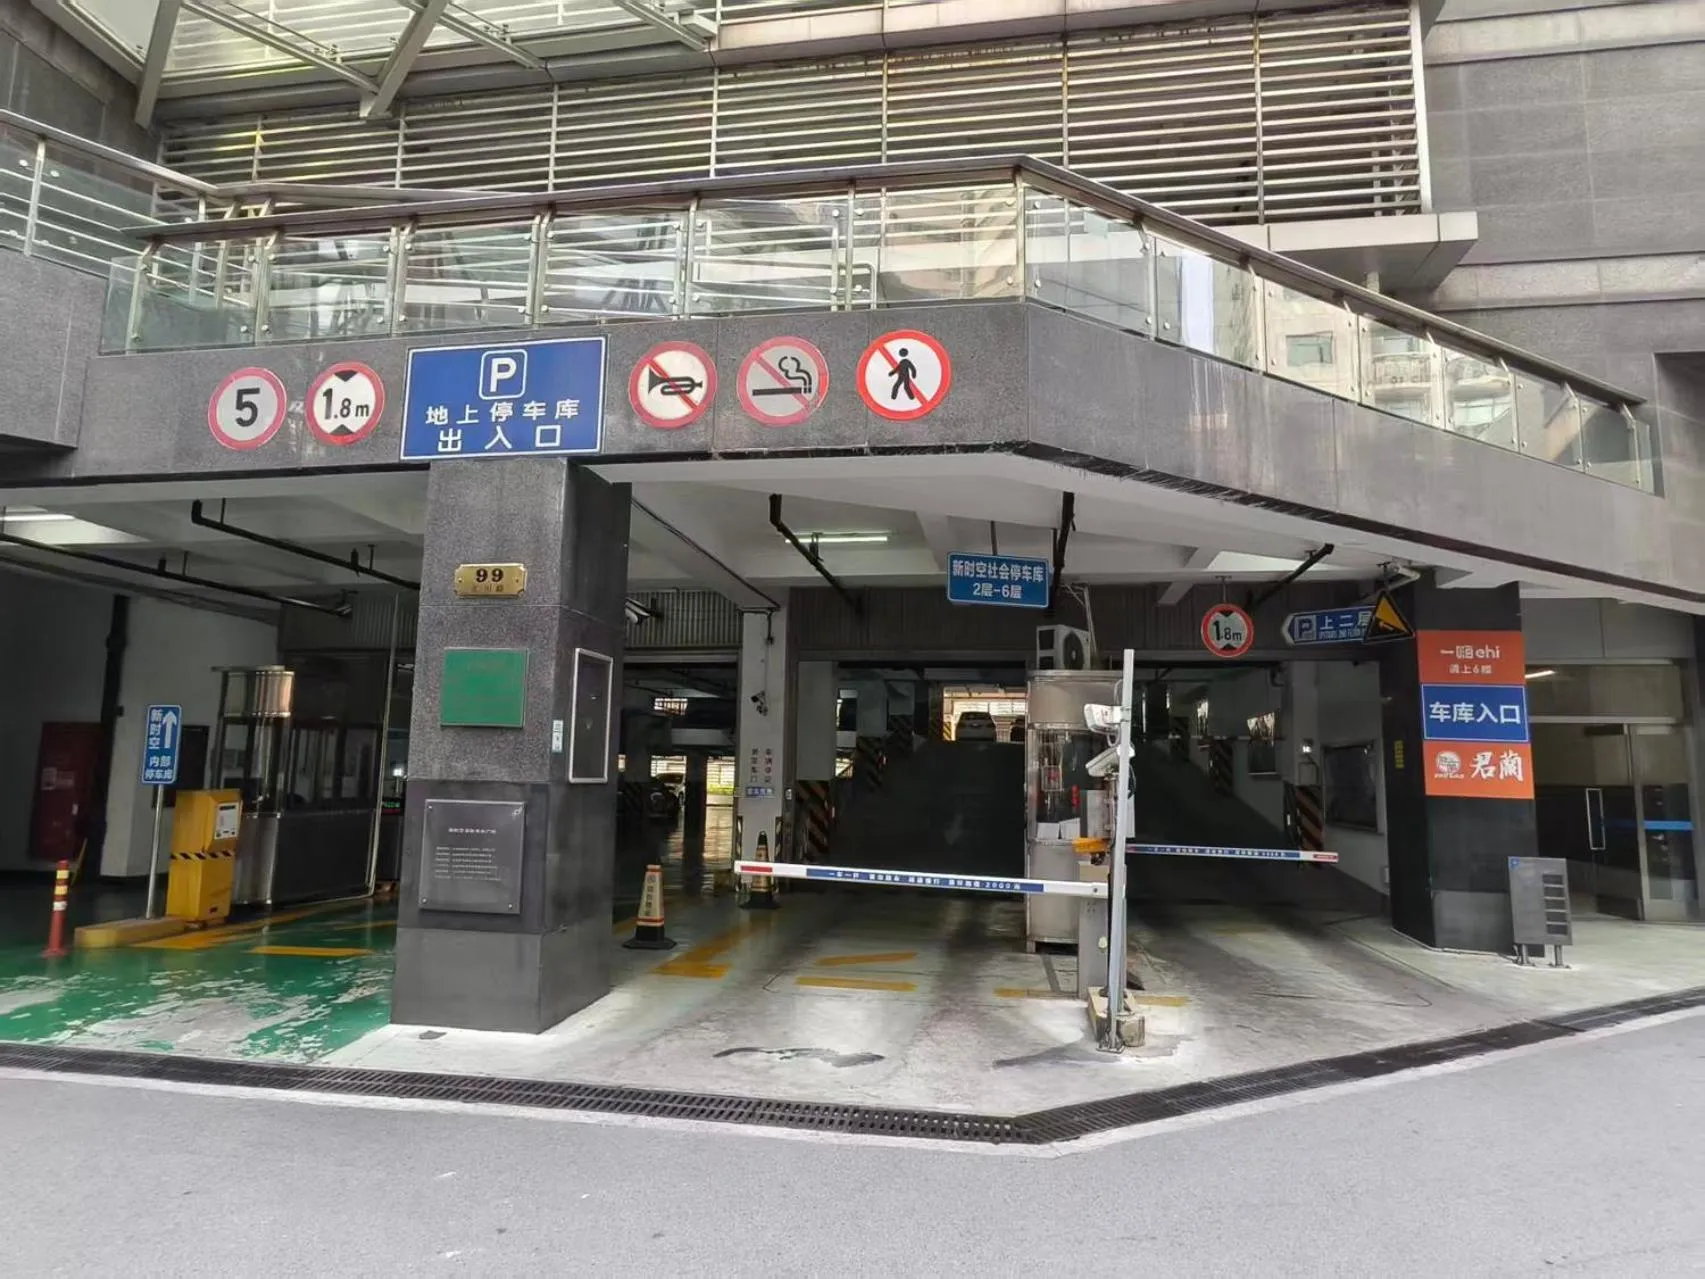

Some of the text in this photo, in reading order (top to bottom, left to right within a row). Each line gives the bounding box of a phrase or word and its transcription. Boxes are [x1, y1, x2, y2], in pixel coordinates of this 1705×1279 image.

[490, 357, 517, 393] P
[235, 387, 261, 427] 5
[322, 388, 370, 420] 1.8m
[425, 398, 580, 426] 地上停车库
[437, 425, 562, 453] 出入口
[476, 568, 504, 583] 99
[952, 559, 1044, 583] 新时空社会停车库
[972, 582, 1022, 599] 2层-6层
[1212, 620, 1242, 641] 1.8m
[1429, 701, 1521, 724] 车库入口
